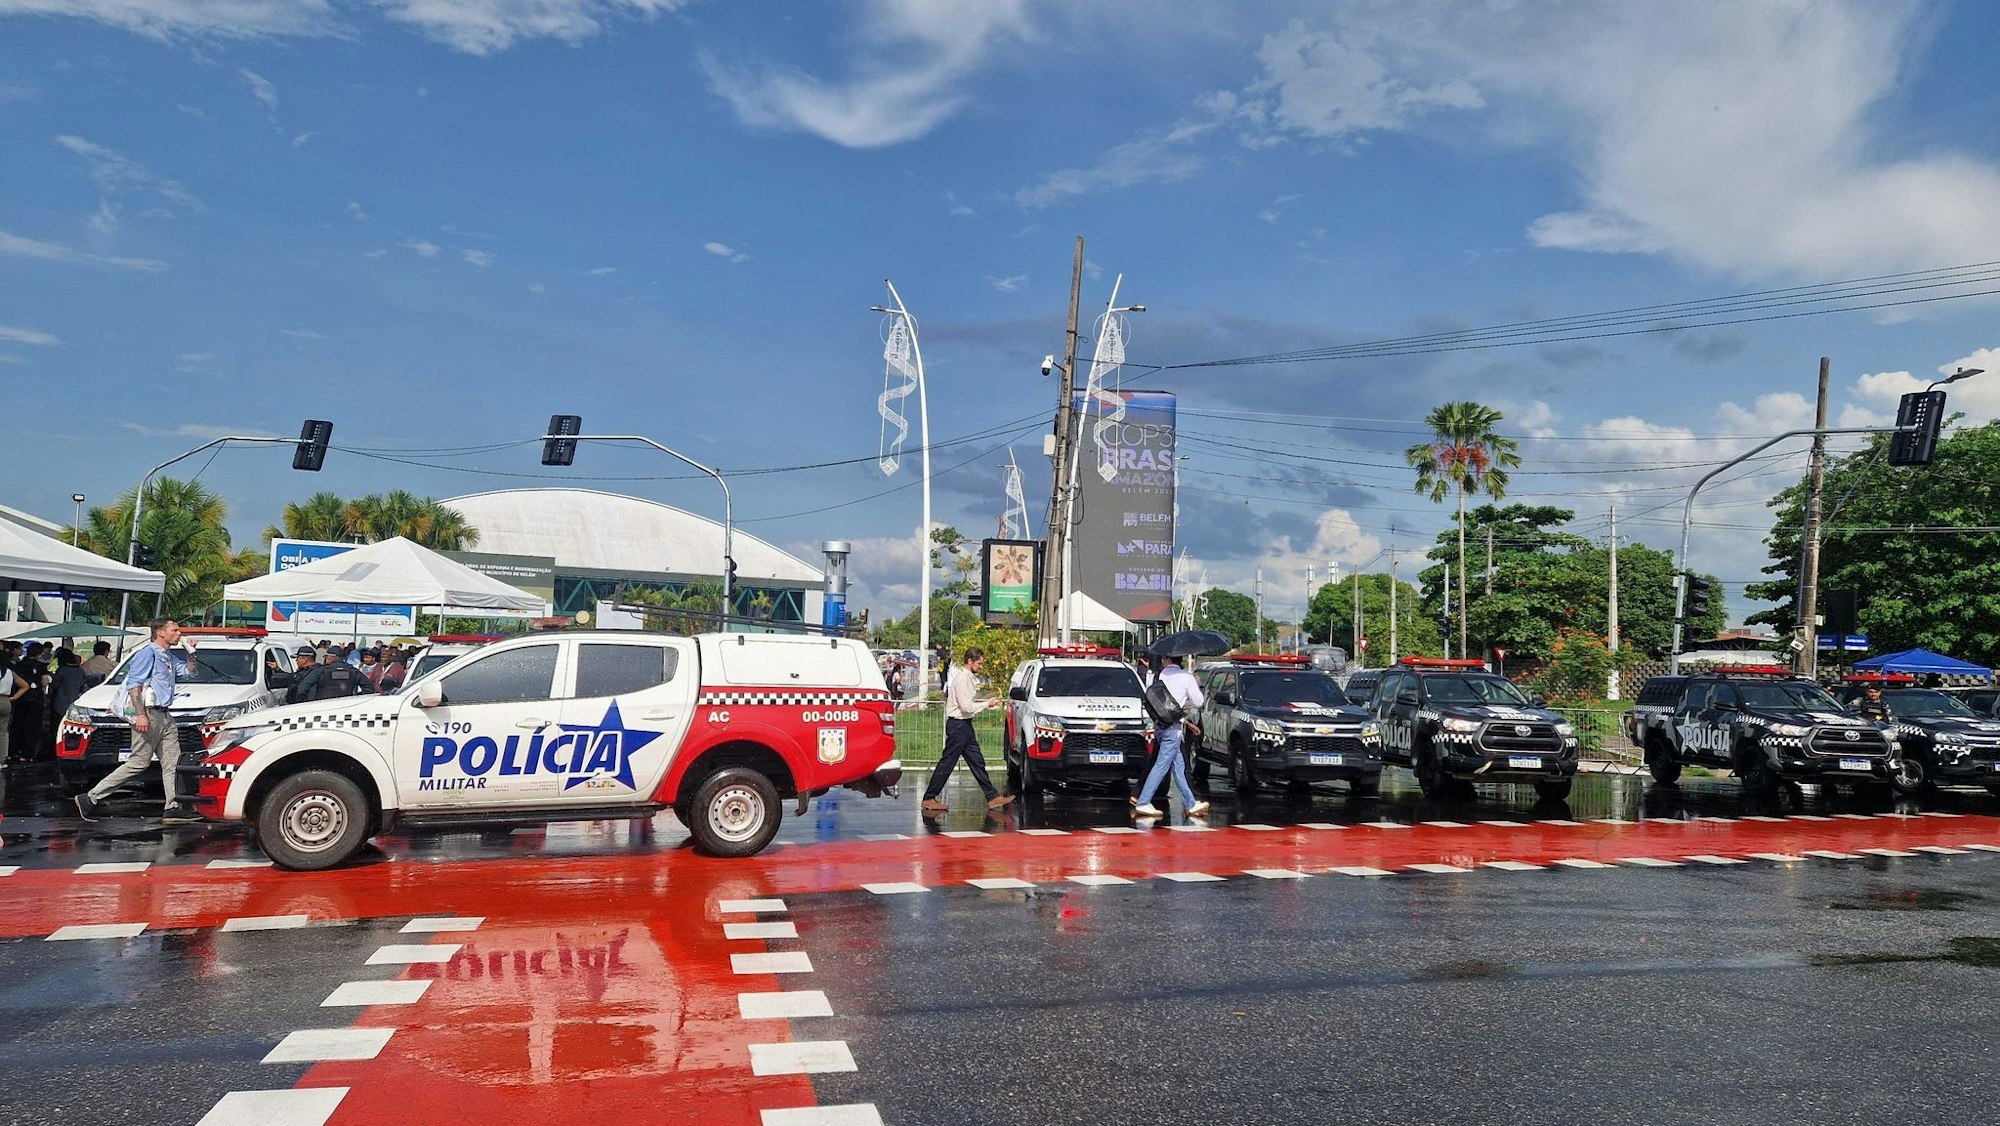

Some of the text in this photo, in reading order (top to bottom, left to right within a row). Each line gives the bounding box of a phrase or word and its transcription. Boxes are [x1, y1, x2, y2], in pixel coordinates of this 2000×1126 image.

[1103, 424, 1175, 447] COP3
[1102, 448, 1175, 471] BRAS
[1114, 572, 1173, 591] BRASIL
[708, 711, 731, 723] AC
[802, 710, 859, 723] 00-0088
[443, 722, 472, 734] 190
[1685, 722, 1731, 752] POLÍCIA
[419, 726, 621, 778] POLÍCIA
[419, 777, 488, 791] MILITAR
